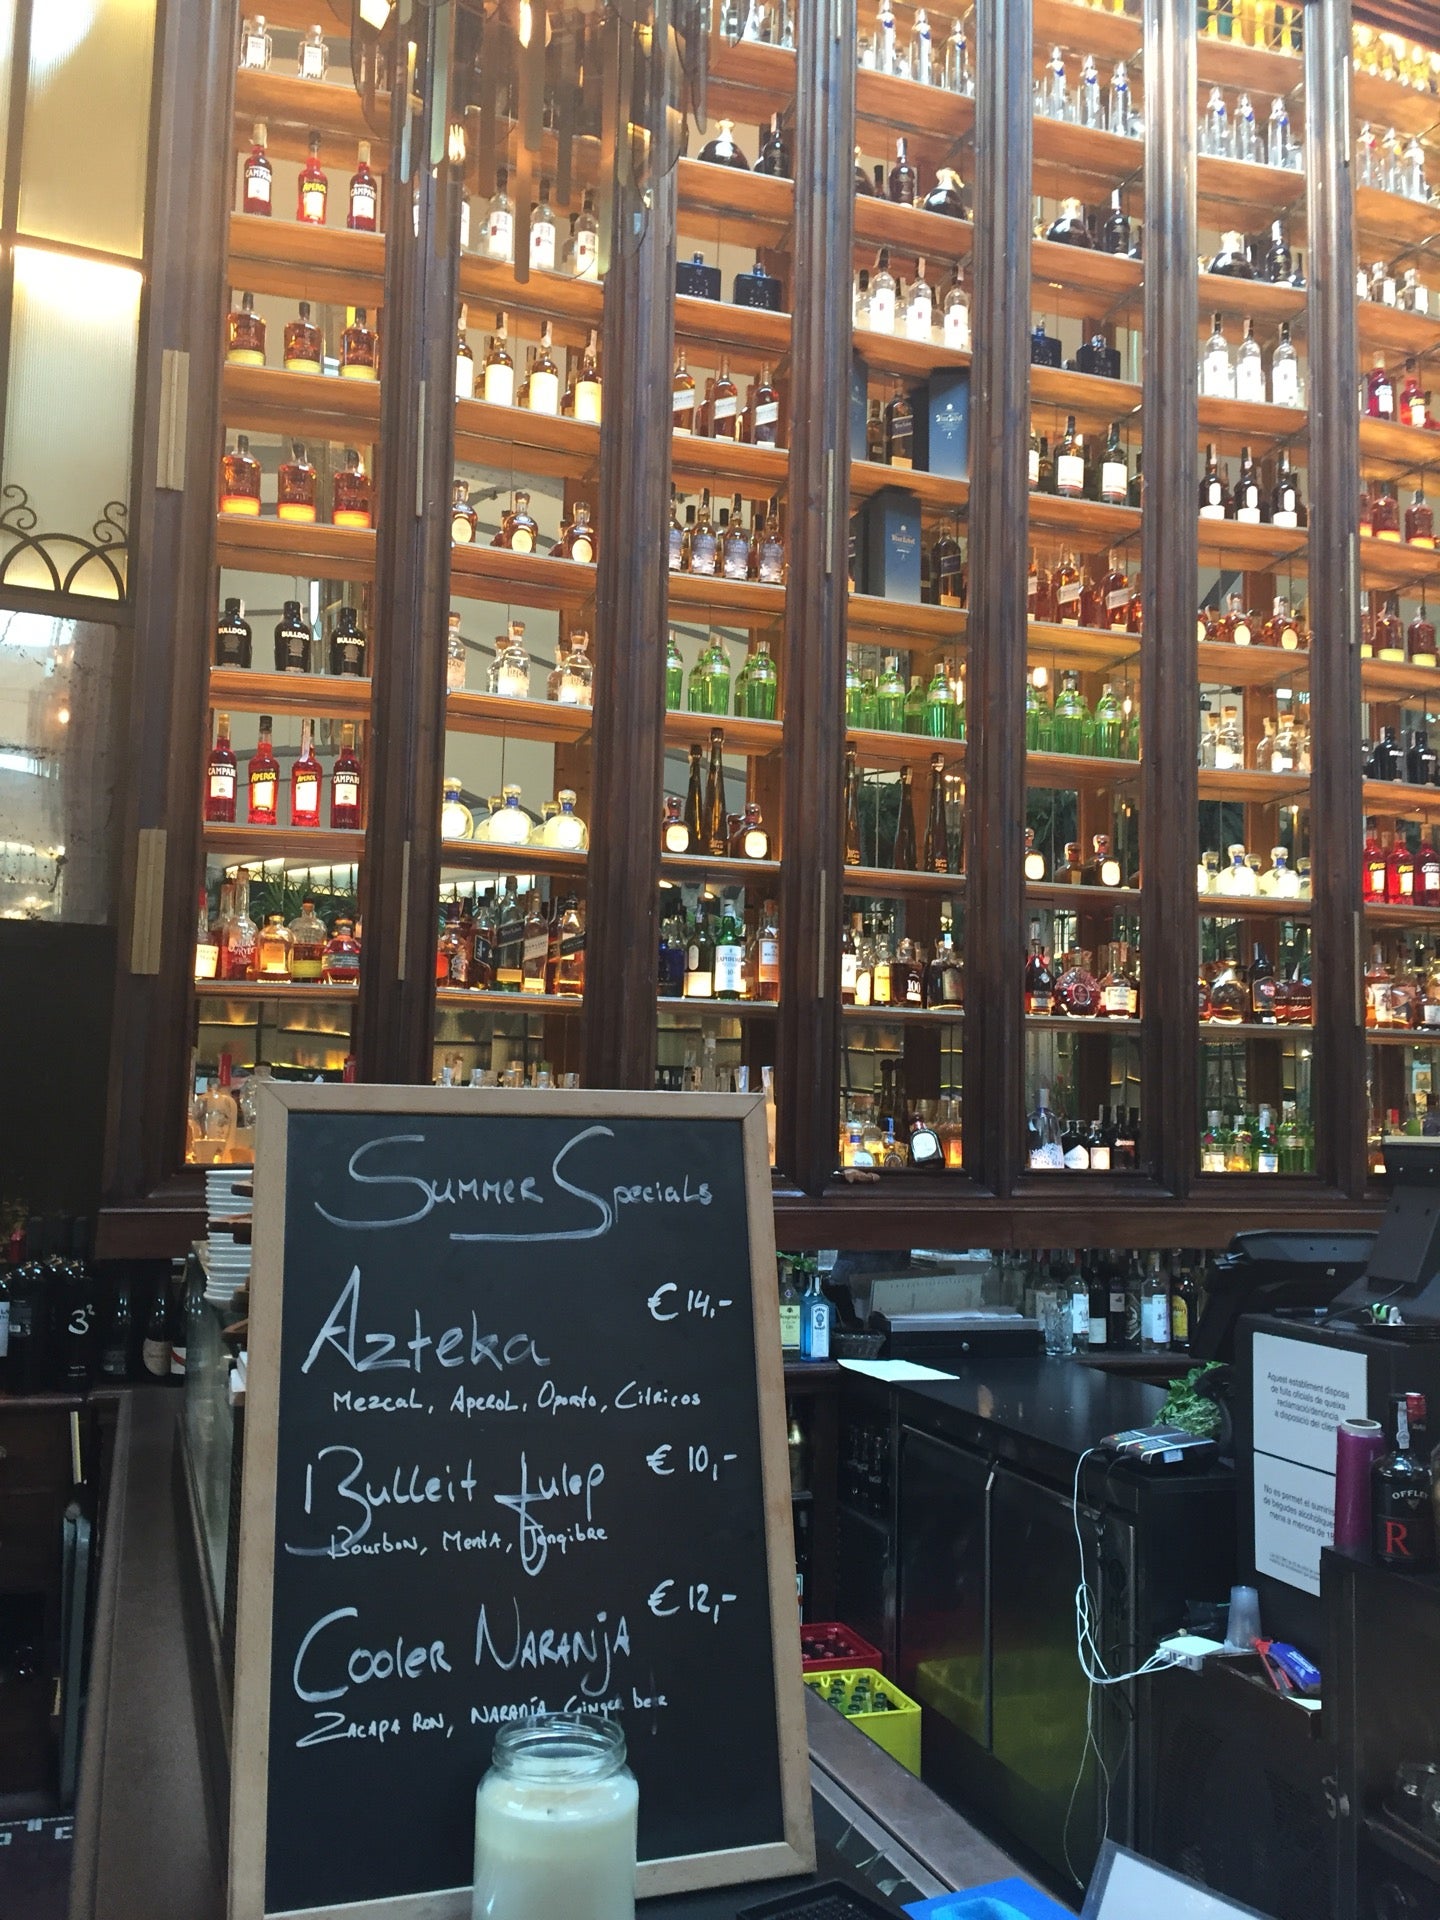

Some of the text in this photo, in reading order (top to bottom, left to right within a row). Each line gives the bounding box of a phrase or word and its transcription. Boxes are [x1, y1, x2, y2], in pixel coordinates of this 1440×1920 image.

[218, 627, 247, 637] BULLDOG
[281, 631, 310, 641] BULLDOG
[336, 637, 365, 647] BULLDOG
[251, 771, 277, 783] APEROL
[907, 980, 921, 993] 100
[450, 1125, 713, 1241] Specials
[301, 1265, 550, 1374] Azteka
[1321, 1422, 1337, 1432] clien
[285, 1445, 606, 1576] Bulleit Julep
[1385, 1520, 1411, 1557] R
[293, 1607, 452, 1702] Cooler
